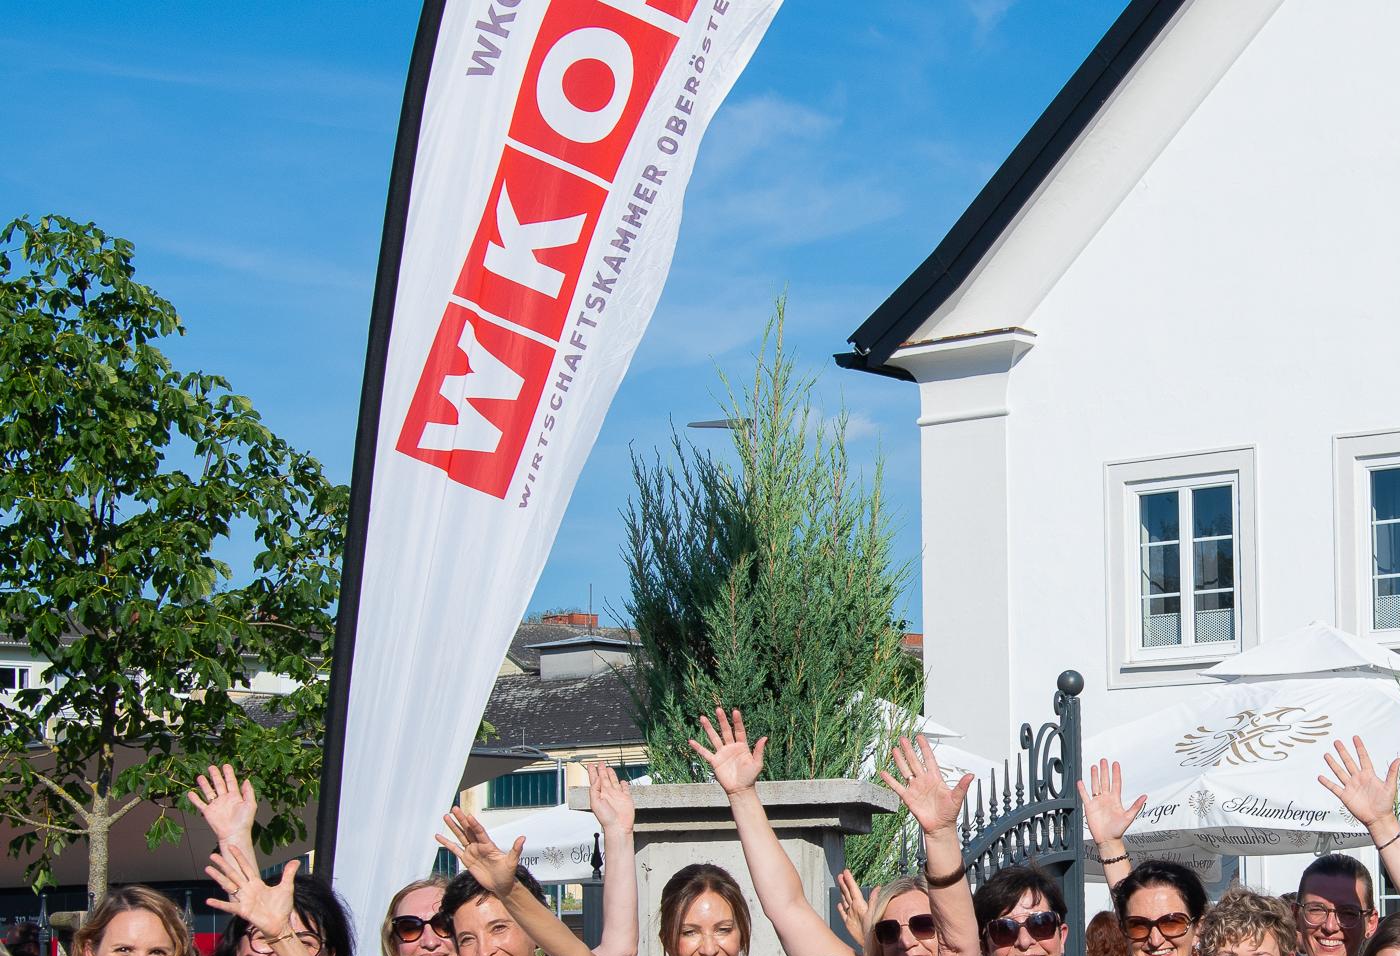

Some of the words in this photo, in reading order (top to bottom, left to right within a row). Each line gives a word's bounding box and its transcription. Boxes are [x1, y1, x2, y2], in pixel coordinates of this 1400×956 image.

[416, 26, 634, 454] WKO
[518, 163, 668, 509] WIRTSCHAFTSKAMMER
[1221, 795, 1331, 827] Schlumberger
